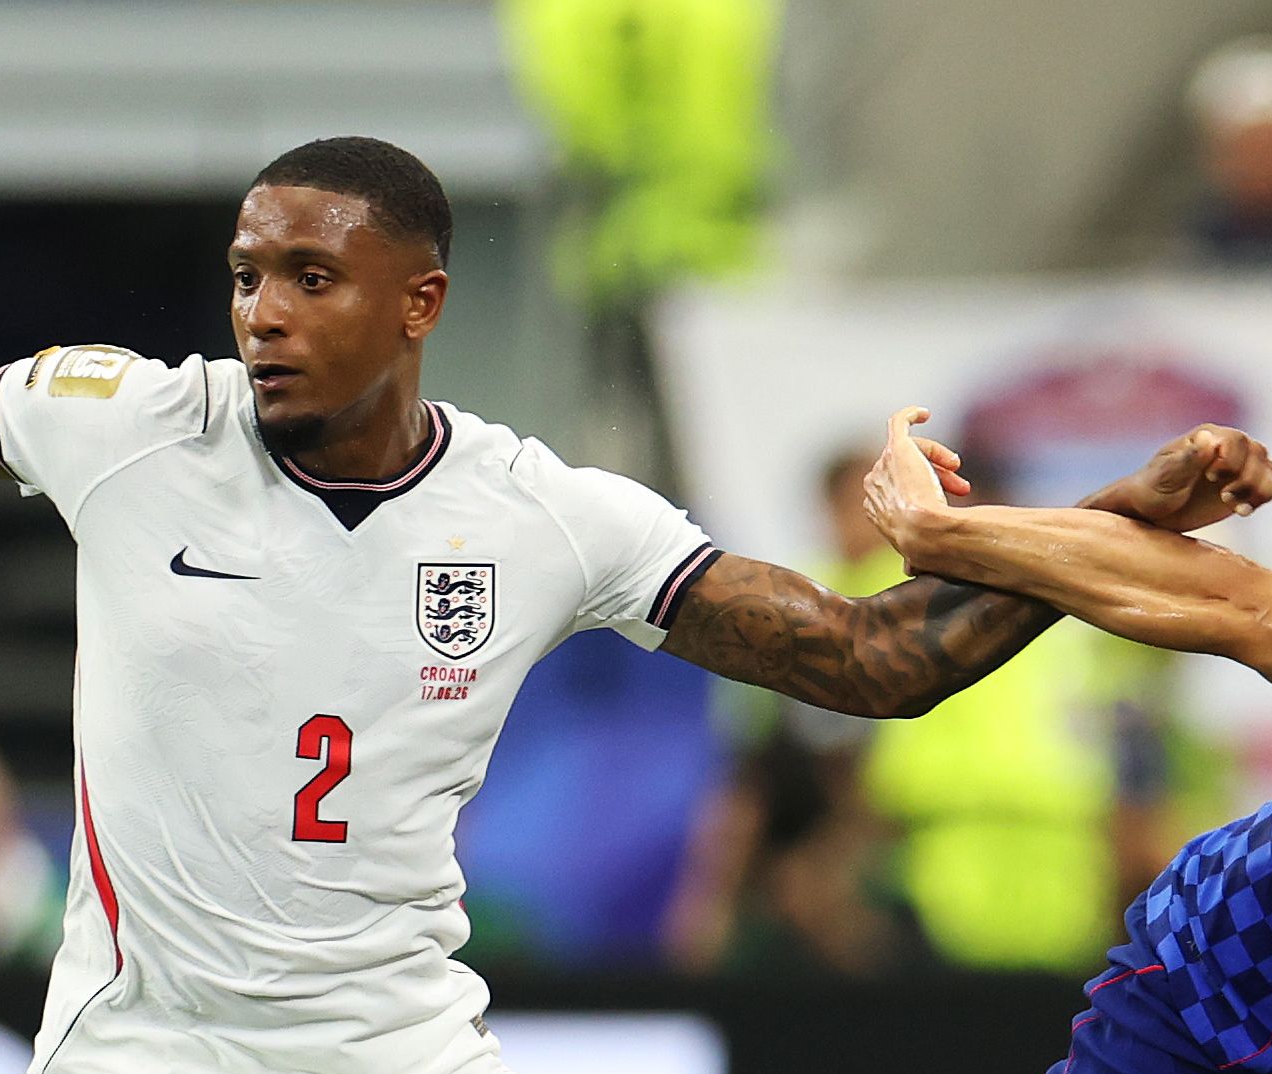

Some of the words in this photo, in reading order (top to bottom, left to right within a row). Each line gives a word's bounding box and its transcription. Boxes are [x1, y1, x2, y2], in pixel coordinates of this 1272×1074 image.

[420, 666, 477, 682] CROATIA
[421, 685, 469, 700] 17.06.26
[292, 714, 353, 843] 2
